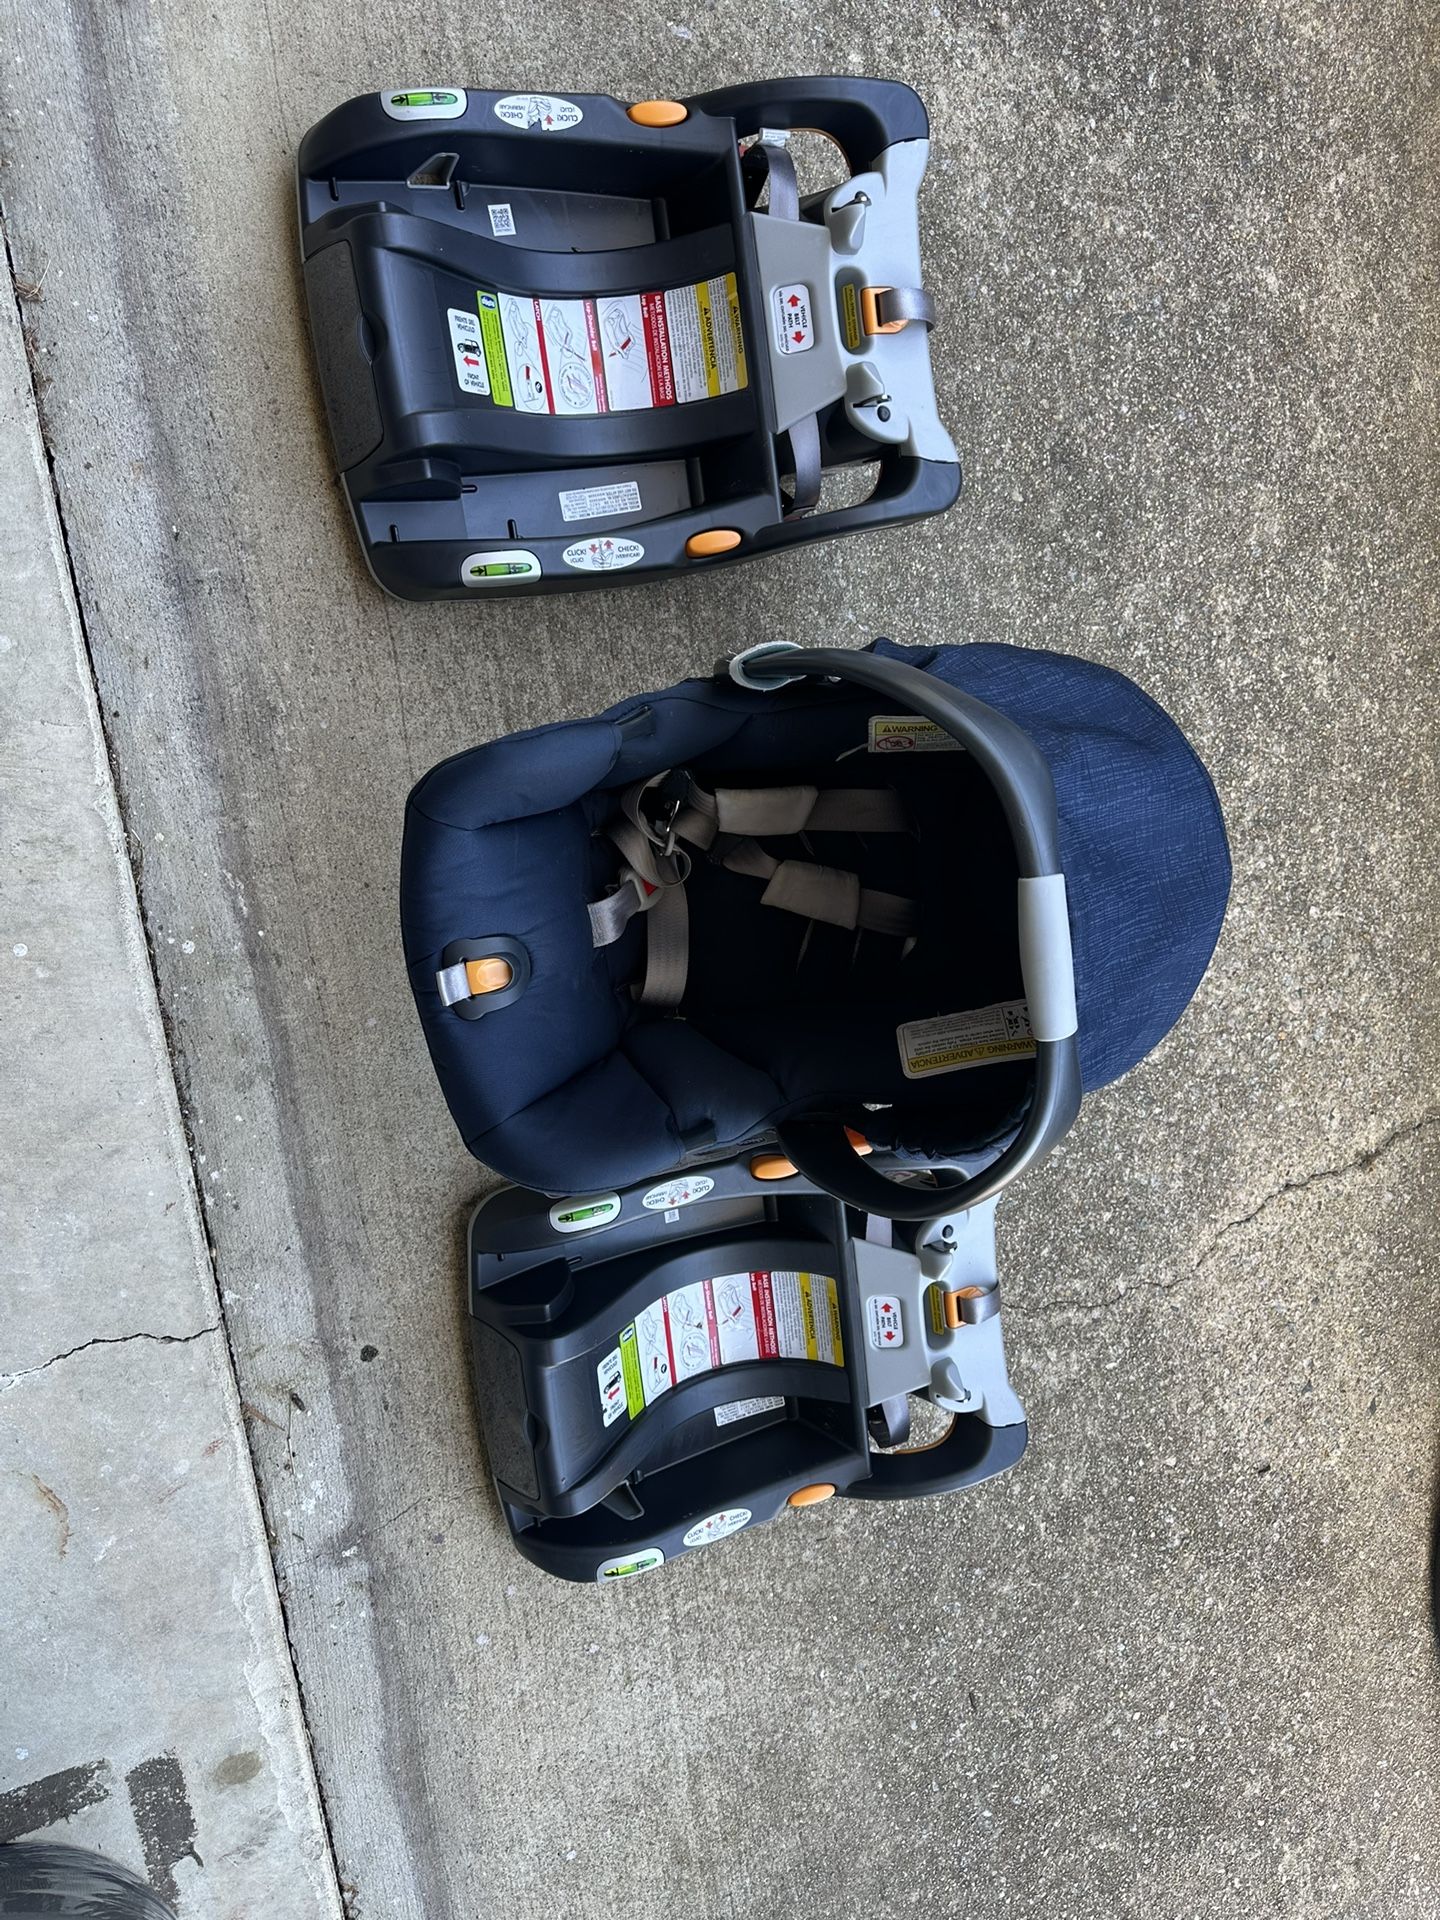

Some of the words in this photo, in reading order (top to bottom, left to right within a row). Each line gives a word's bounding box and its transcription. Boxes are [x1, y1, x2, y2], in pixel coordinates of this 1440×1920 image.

[654, 295, 663, 314] BASE
[657, 315, 669, 364] INSTALLATION
[704, 316, 716, 369] ADVERTENCIA
[733, 314, 743, 354] WARNING
[662, 363, 673, 400] METHODS
[891, 725, 938, 733] WARNING
[910, 1050, 974, 1068] ADVERTENCIA
[987, 1040, 1032, 1053] WARNING
[762, 1273, 770, 1288] BASE
[763, 1289, 774, 1326] INSTALLATION
[806, 1298, 816, 1340] ADVERTENCIA
